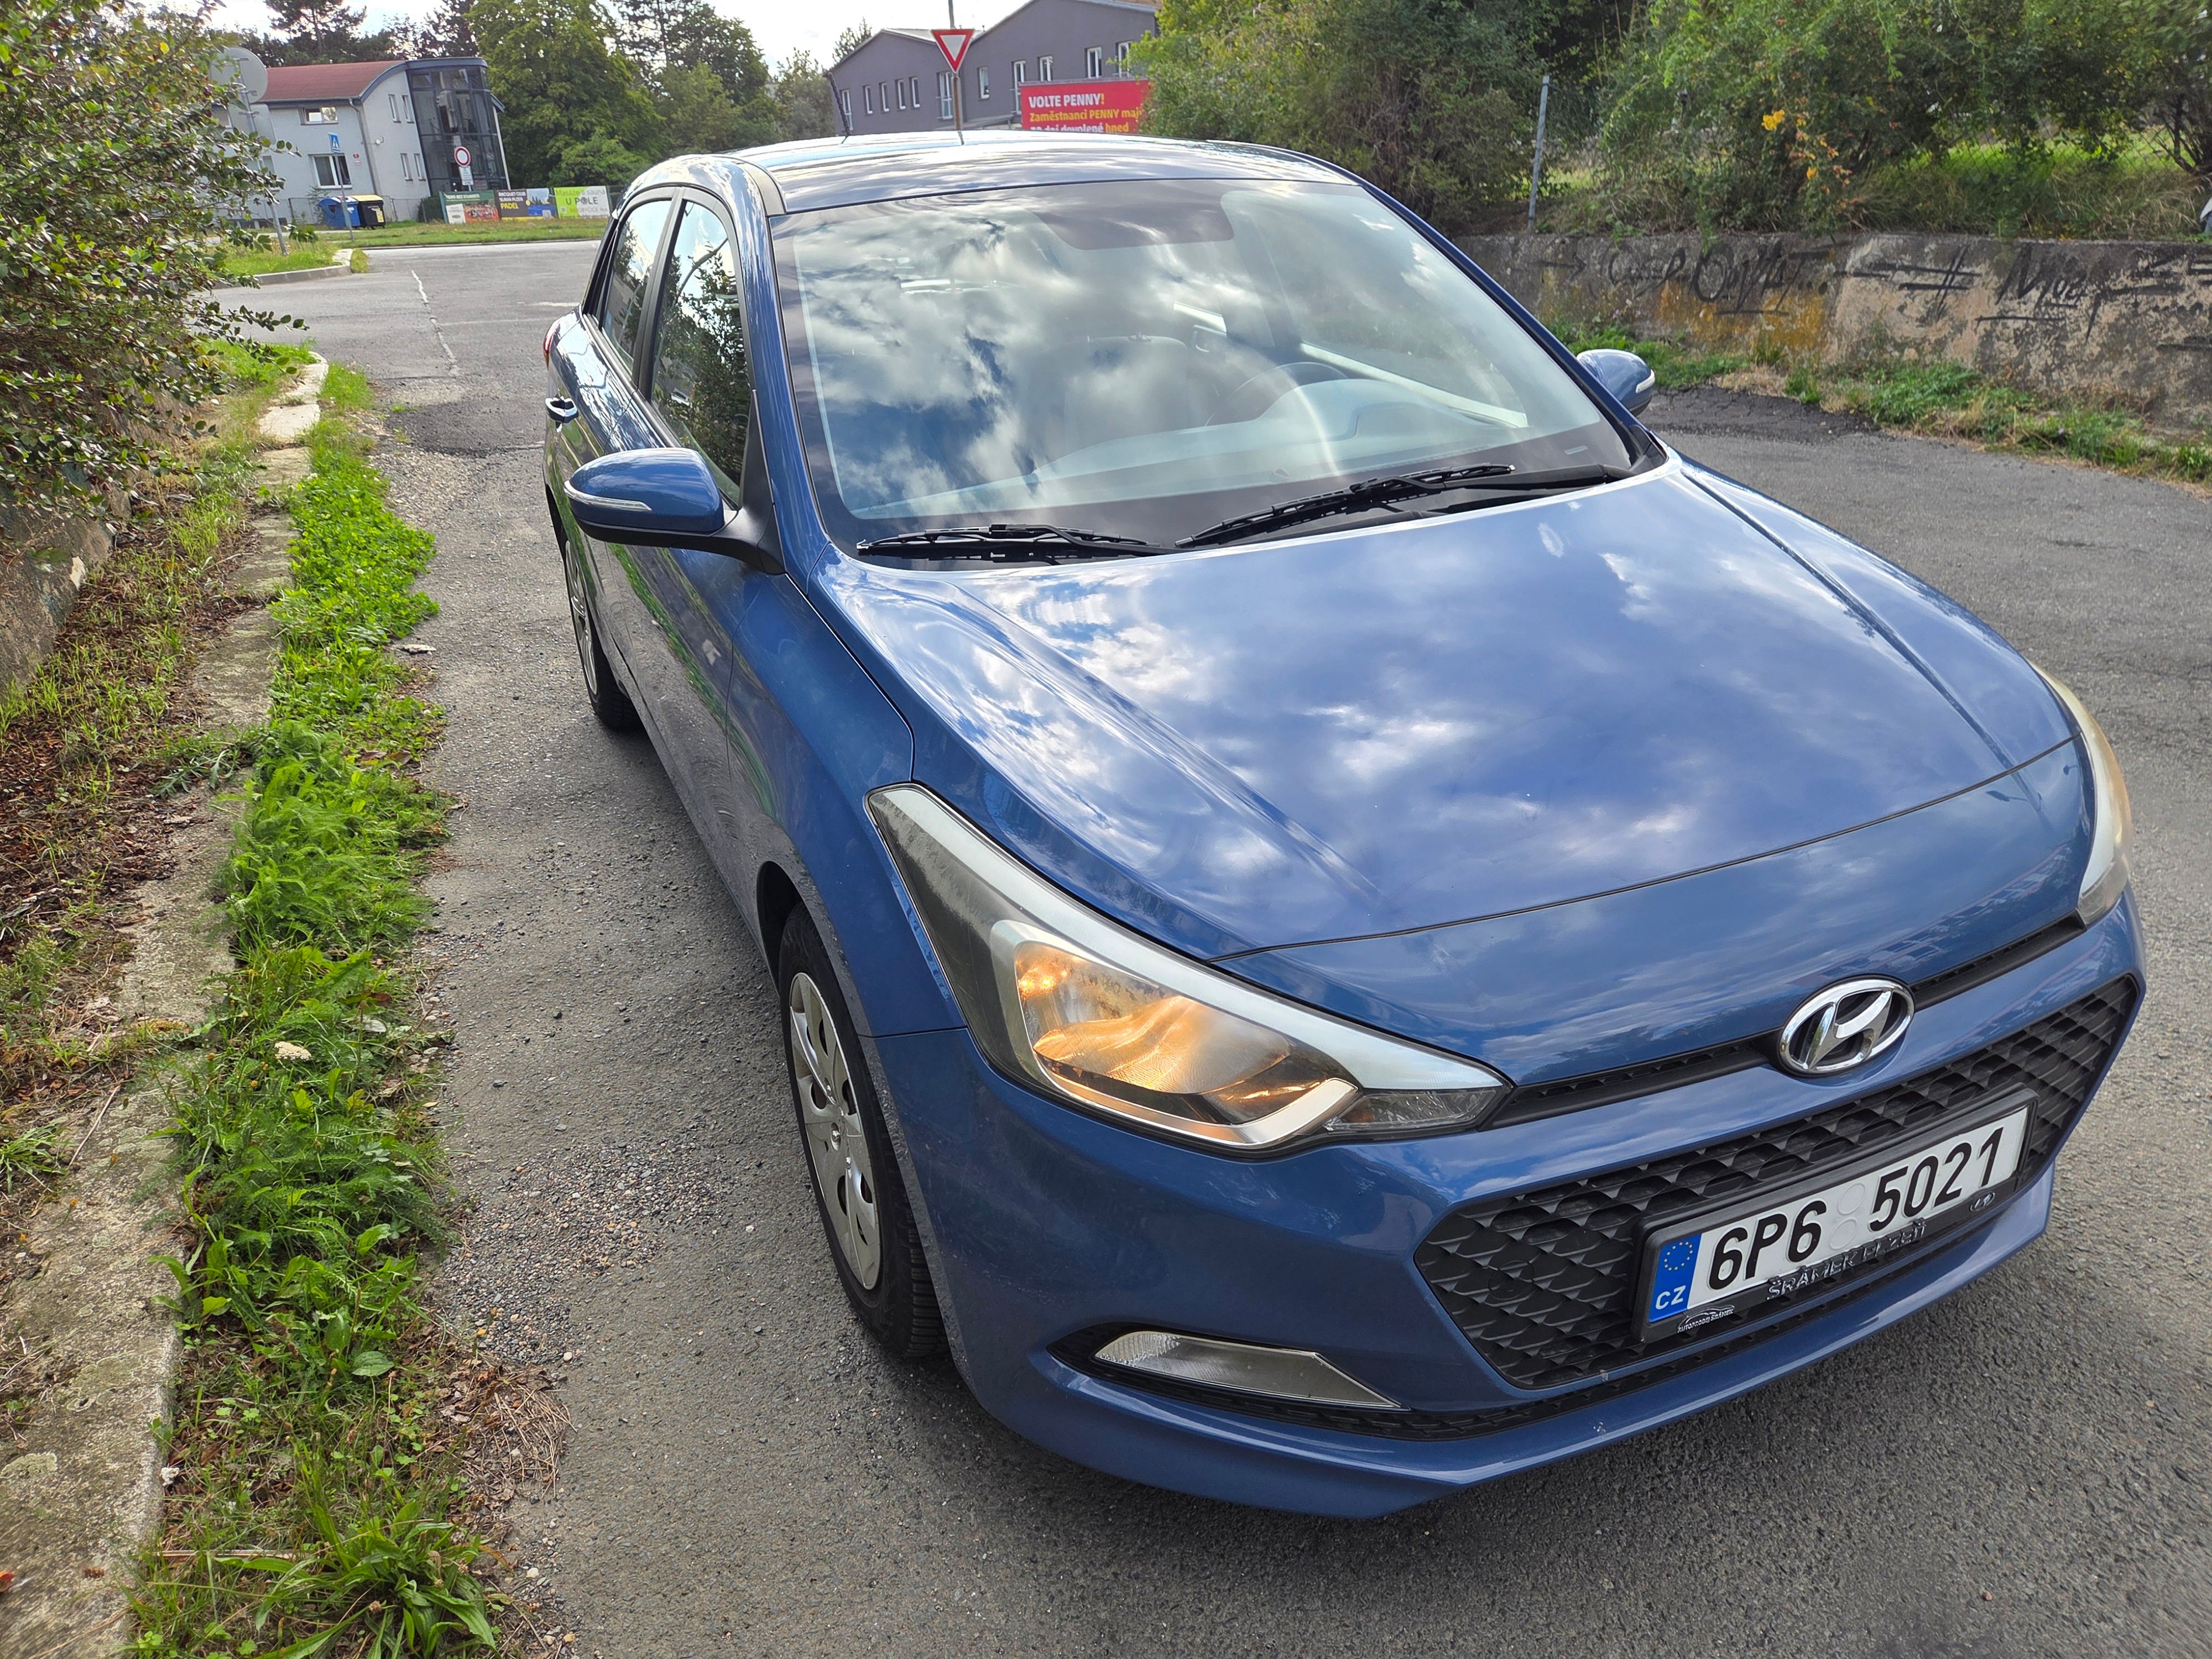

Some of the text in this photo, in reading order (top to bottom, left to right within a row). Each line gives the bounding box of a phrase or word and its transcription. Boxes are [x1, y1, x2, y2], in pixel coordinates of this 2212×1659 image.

[1029, 93, 1104, 108] VOLTE PENNY!
[1030, 108, 1087, 122] Zaměstnanci
[1089, 108, 1119, 120] PENNY
[1105, 122, 1129, 133] hned
[1709, 1126, 2005, 1290] 6P6 5021
[1655, 1285, 1684, 1310] CZ
